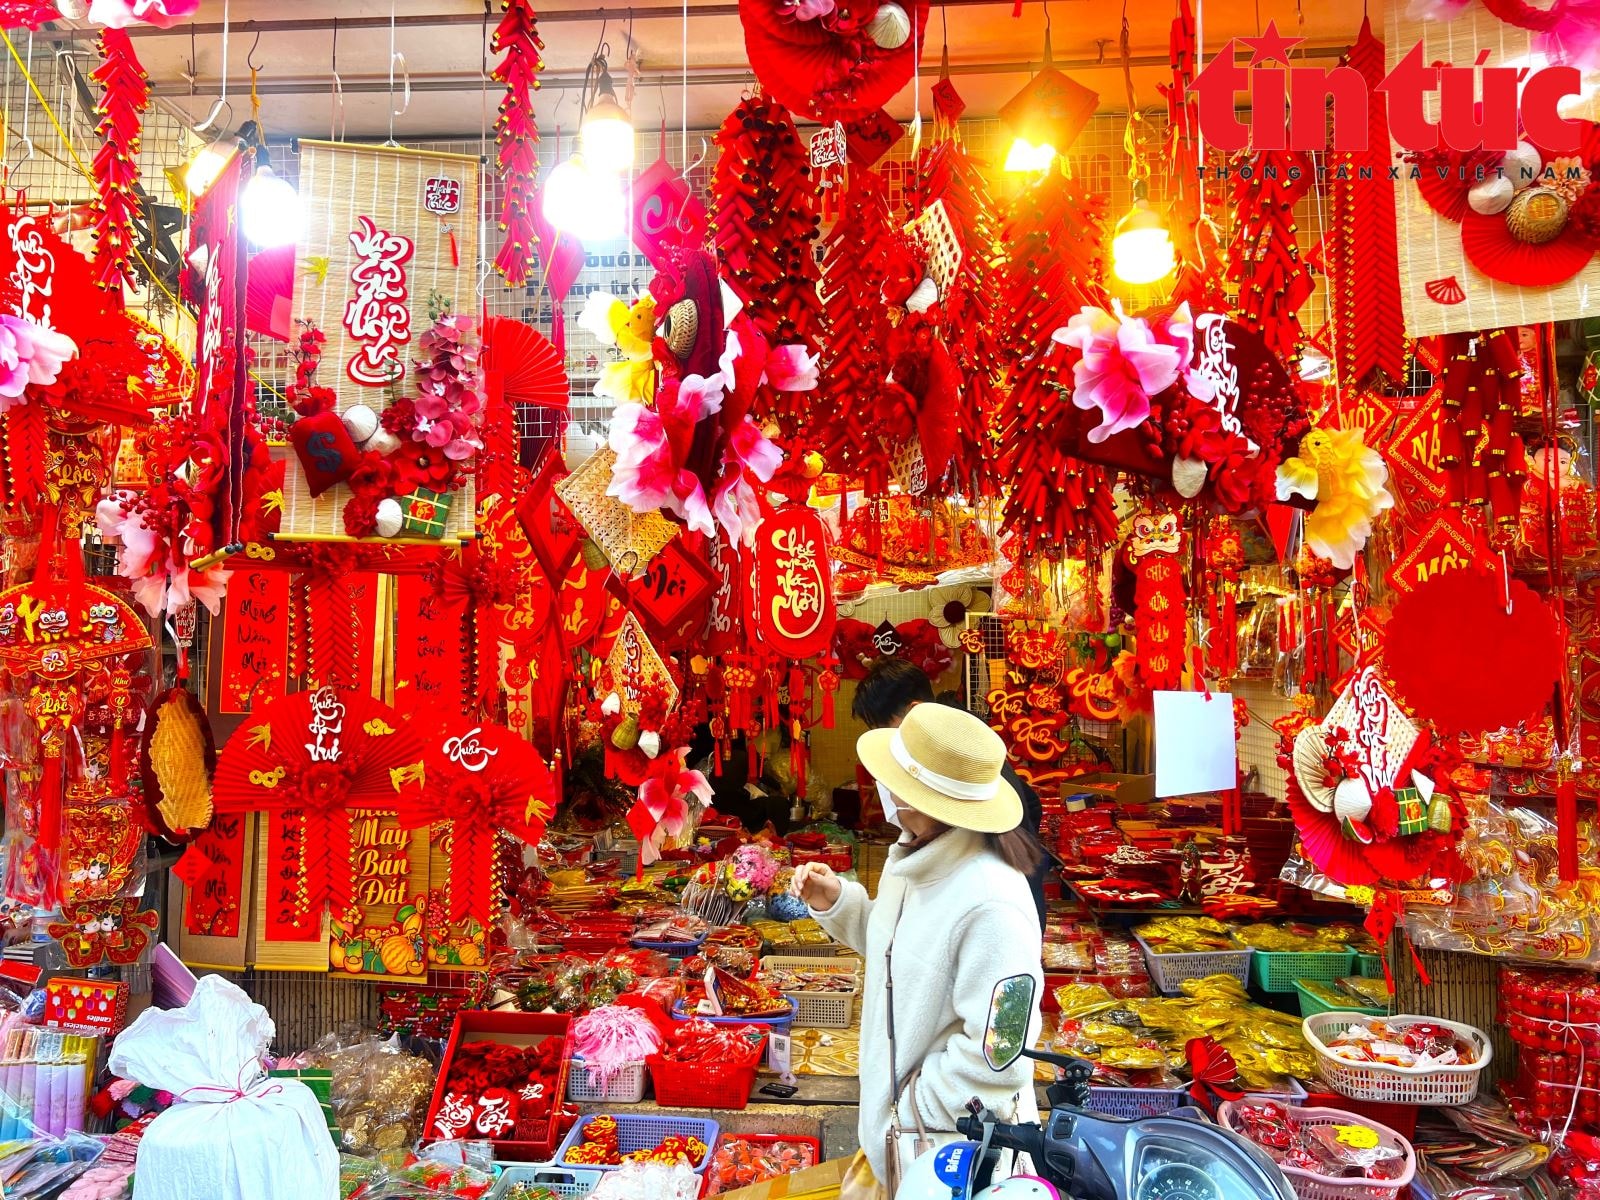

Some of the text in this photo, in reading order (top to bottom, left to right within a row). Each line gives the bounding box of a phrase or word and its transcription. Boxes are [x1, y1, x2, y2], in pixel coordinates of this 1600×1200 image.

[1411, 408, 1444, 474] NĂ
[58, 464, 93, 488] Lộc
[309, 685, 346, 720] Xuân
[442, 727, 498, 772] Xuân
[1012, 718, 1069, 760] Xuân
[354, 819, 411, 850] May
[358, 849, 410, 877] Bán
[358, 877, 407, 905] Đắt
[476, 1096, 514, 1136] Tết
